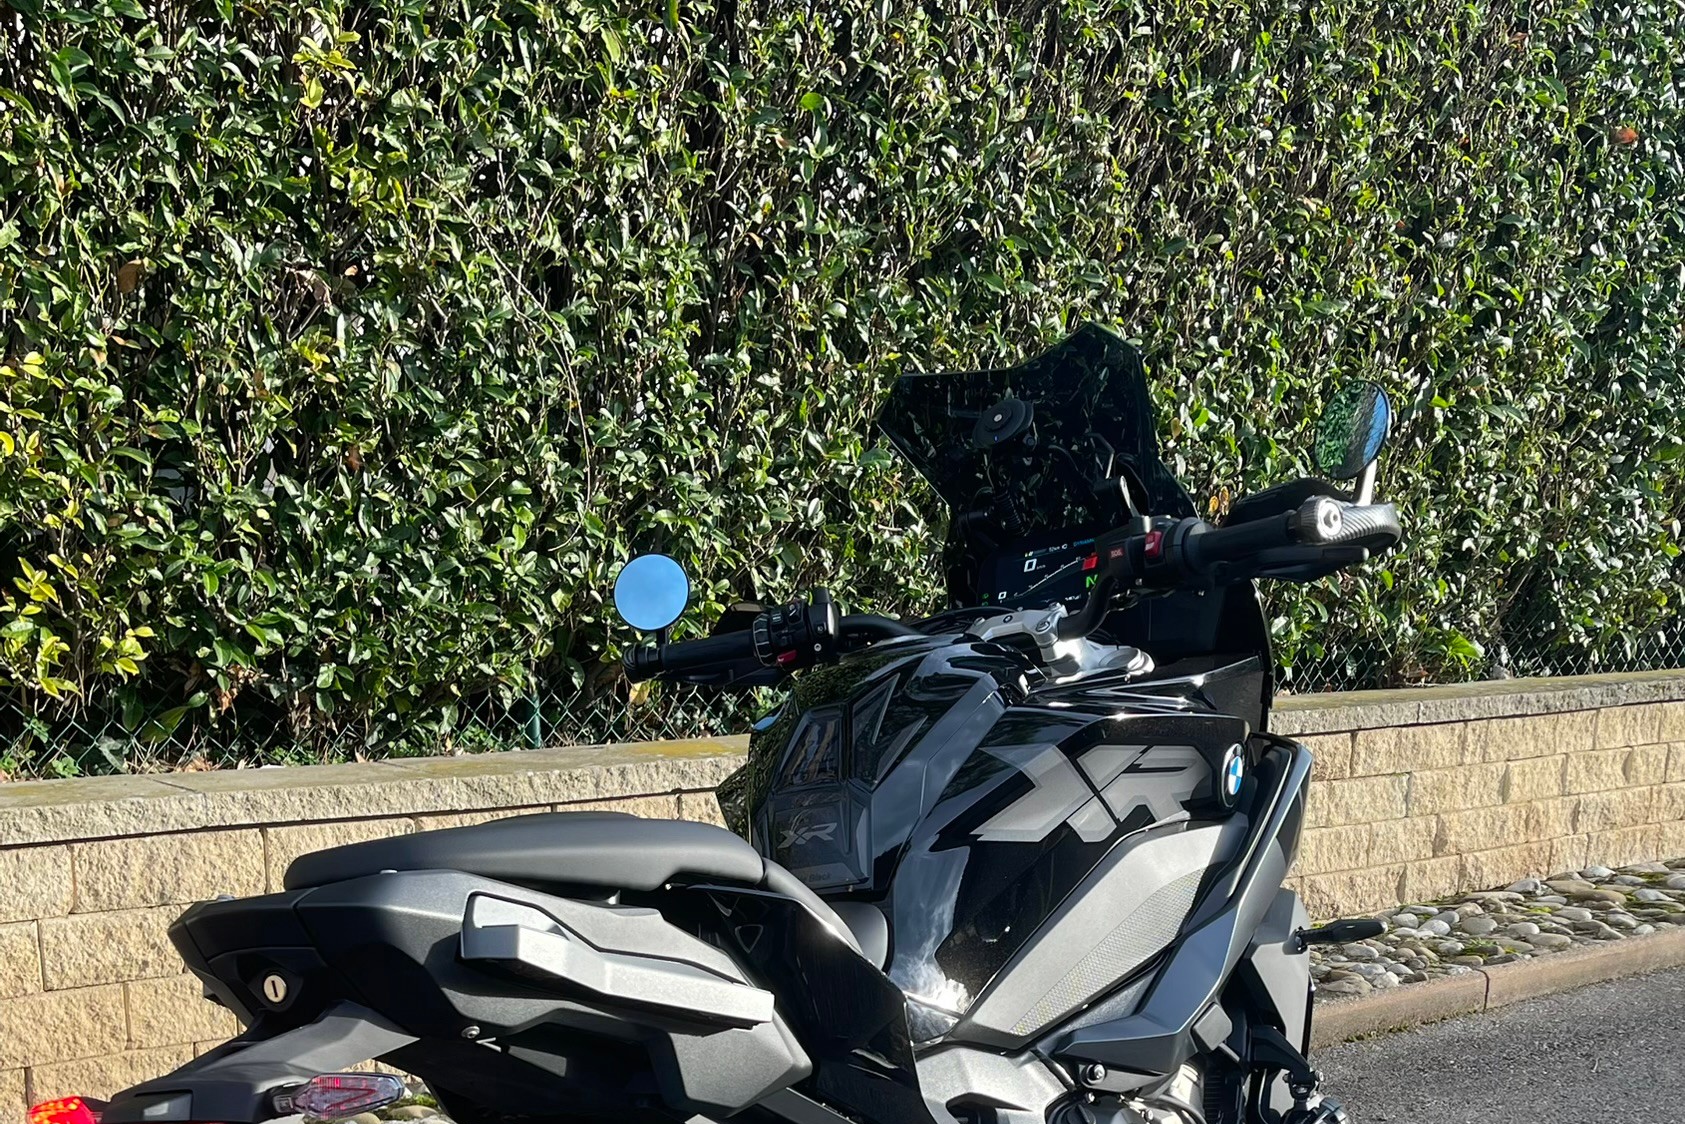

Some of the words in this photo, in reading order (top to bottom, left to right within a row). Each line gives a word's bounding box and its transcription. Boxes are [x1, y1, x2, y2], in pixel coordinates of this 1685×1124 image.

[1085, 574, 1098, 588] N
[970, 743, 1214, 843] XR
[777, 822, 838, 849] XR
